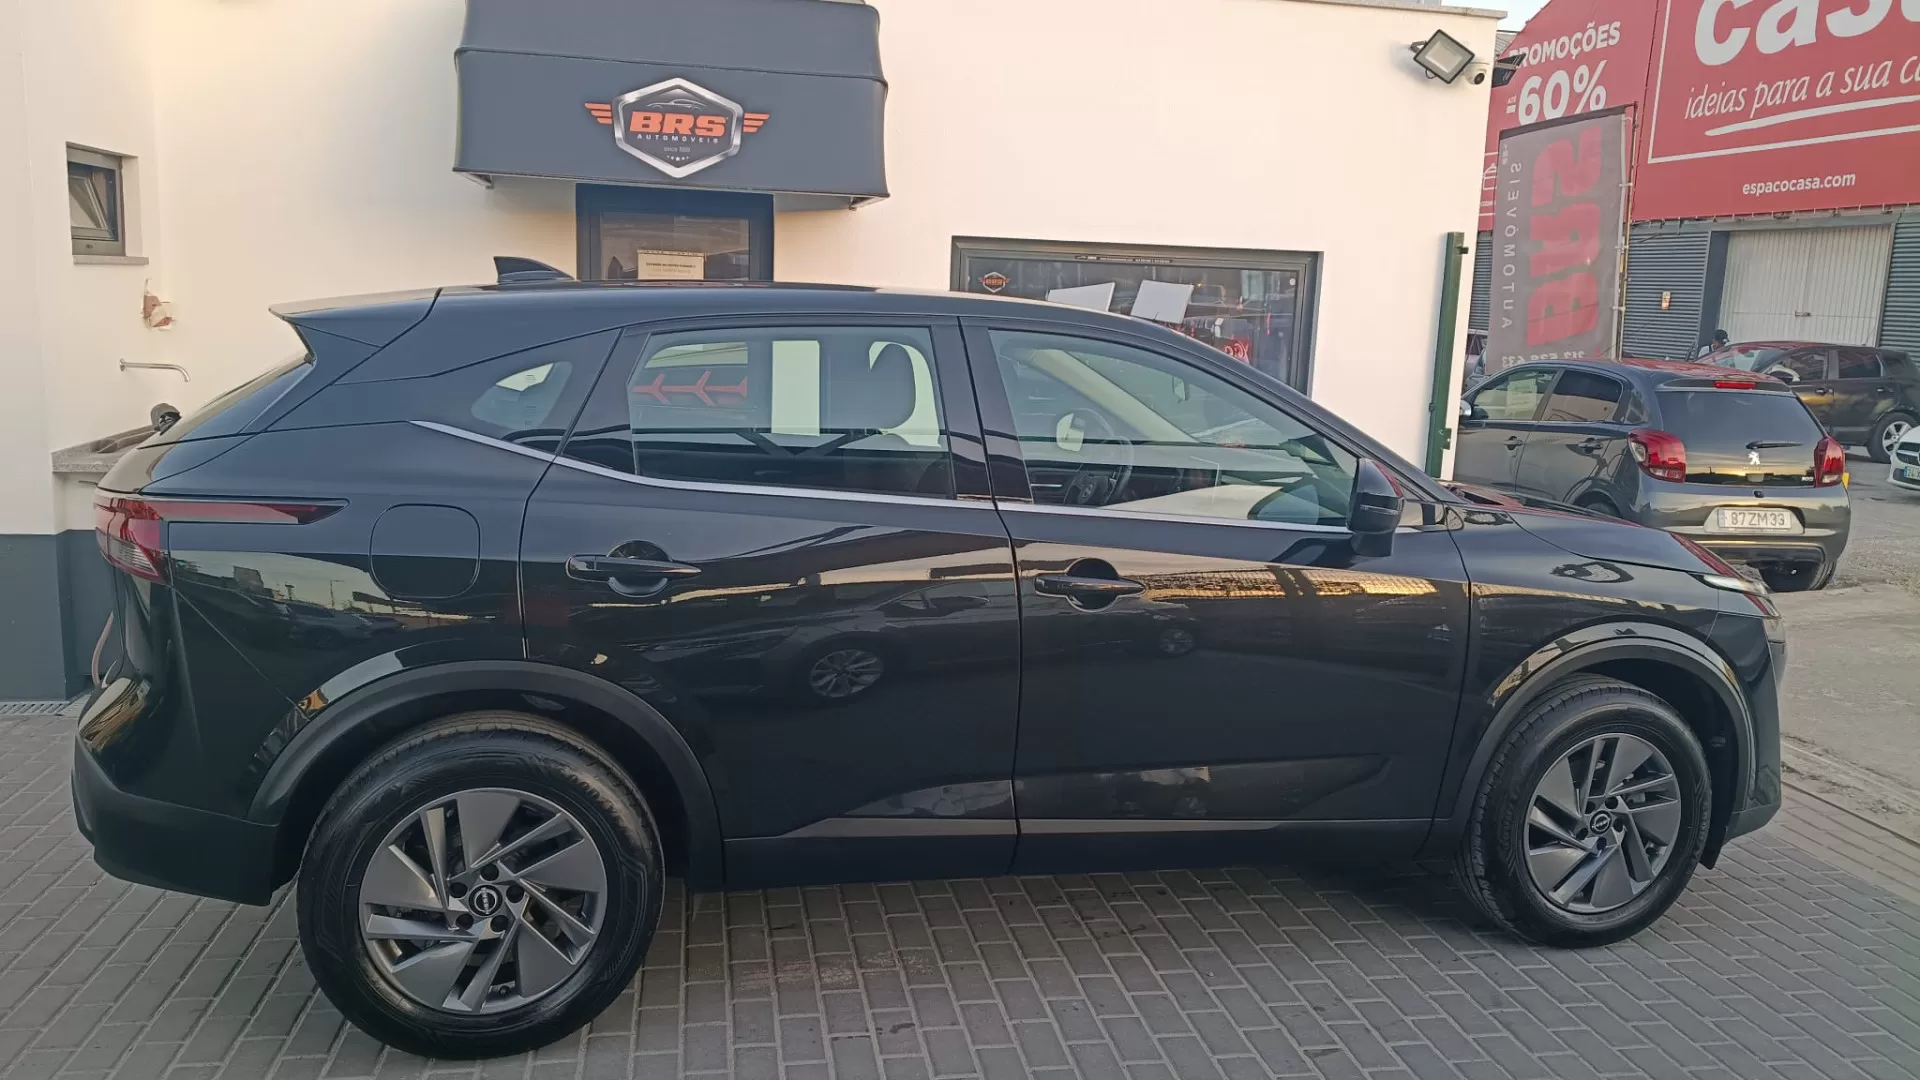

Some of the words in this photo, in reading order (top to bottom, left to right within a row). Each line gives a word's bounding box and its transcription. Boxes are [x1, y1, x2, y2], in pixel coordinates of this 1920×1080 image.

[1695, 0, 1920, 66] ca
[1684, 81, 1748, 120] ideias
[1750, 75, 1811, 118] para
[1815, 70, 1835, 98] a
[1840, 60, 1893, 94] sua
[629, 111, 726, 137] BRS
[1742, 173, 1856, 197] espacocasa.com
